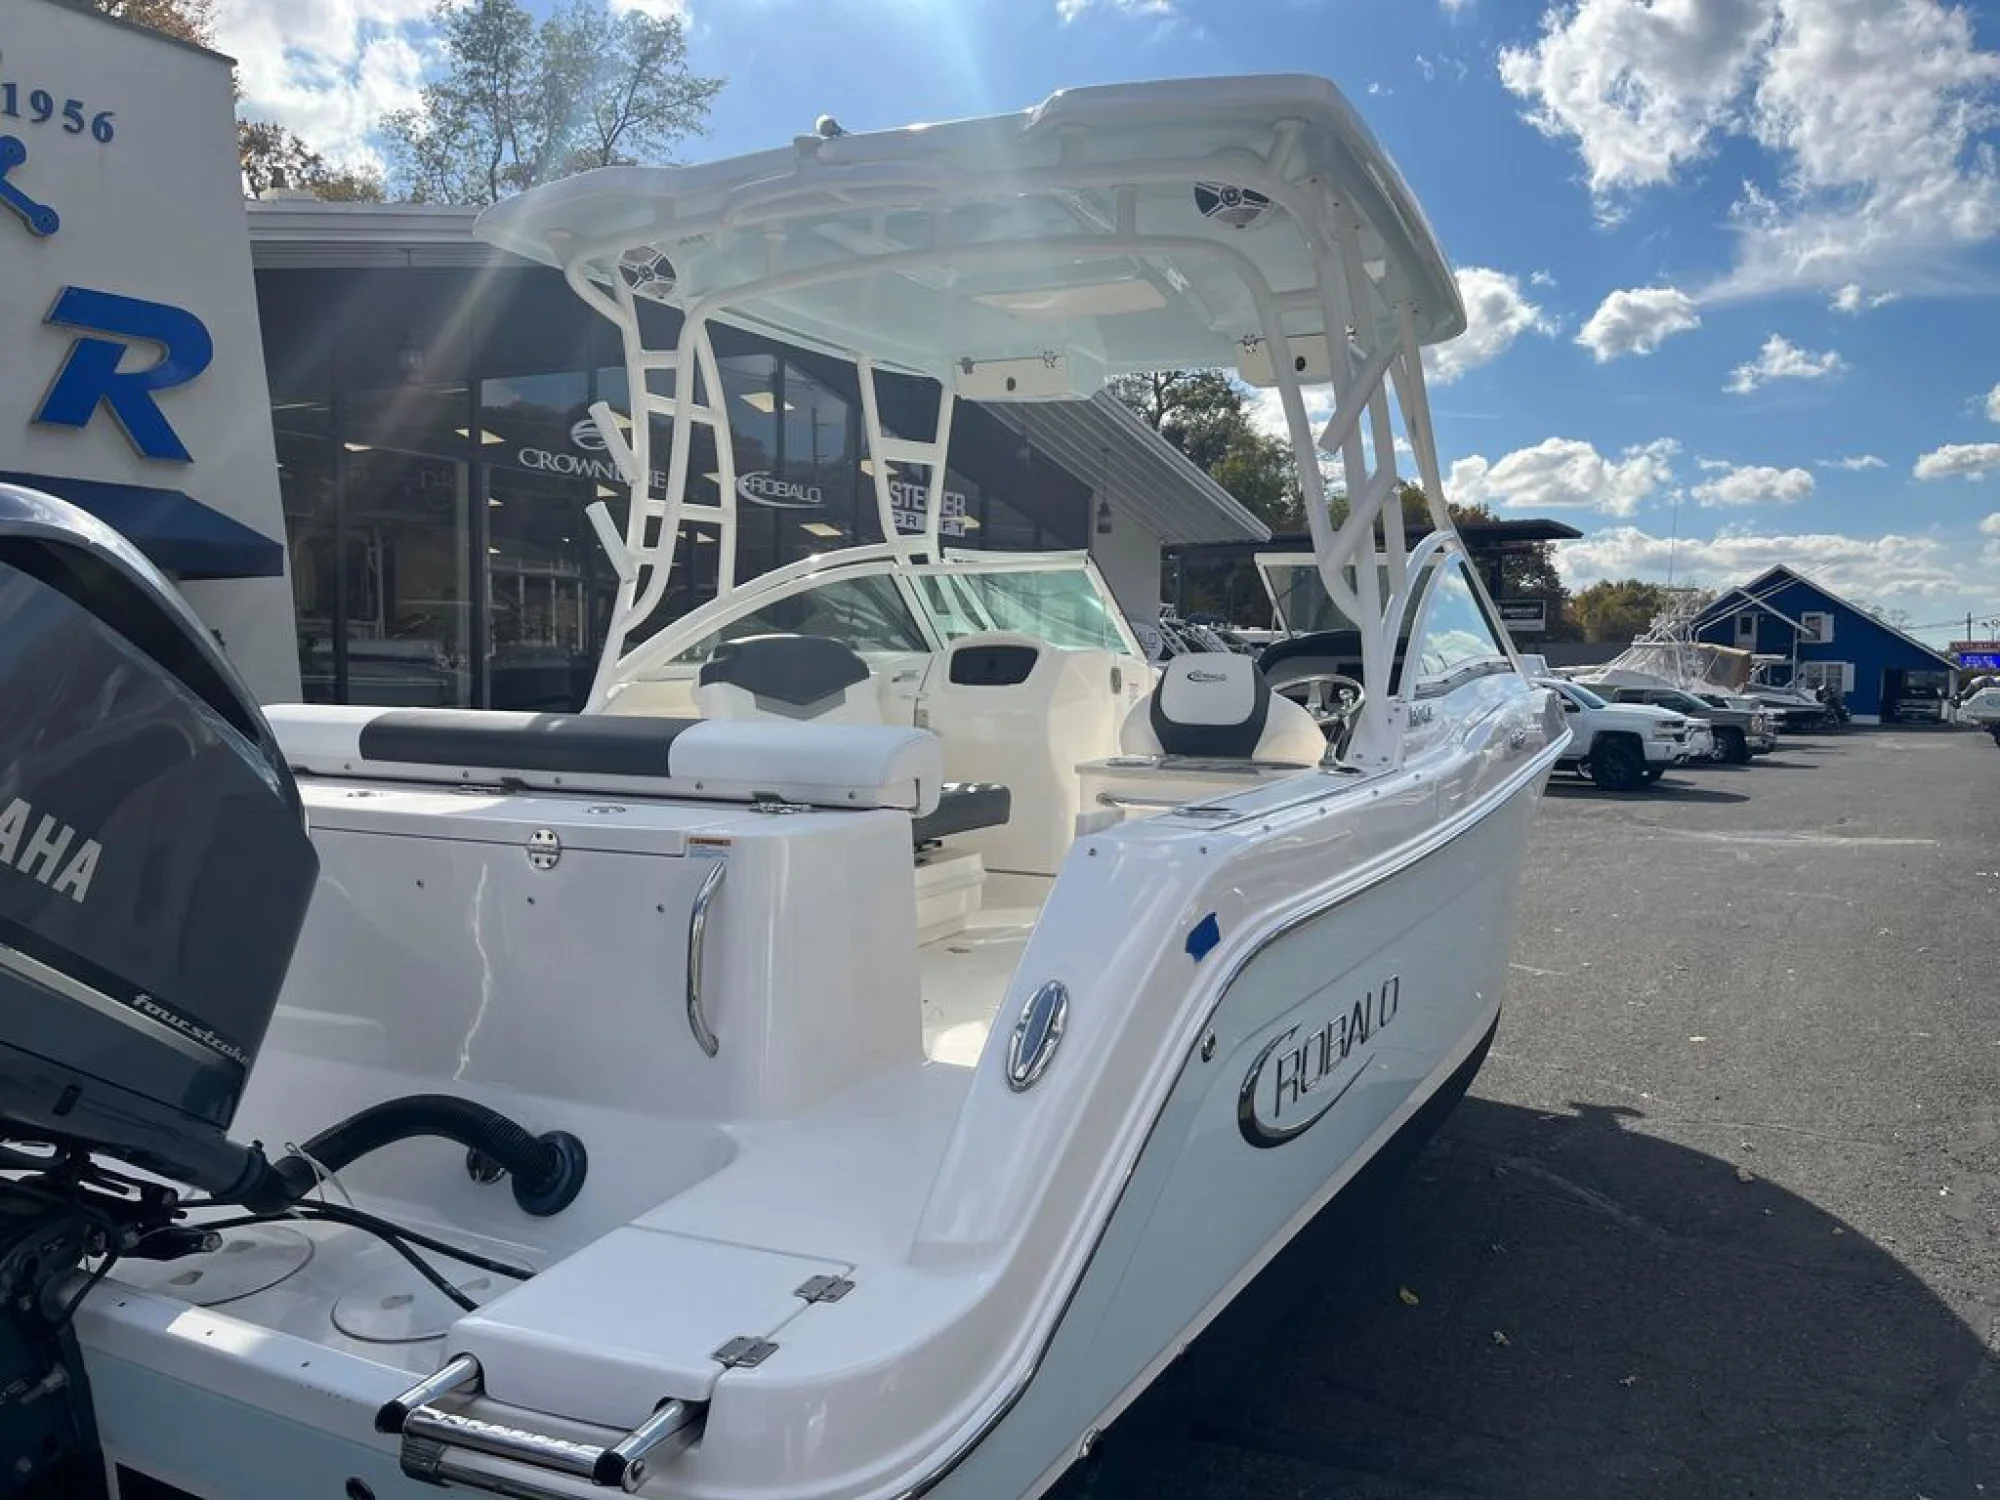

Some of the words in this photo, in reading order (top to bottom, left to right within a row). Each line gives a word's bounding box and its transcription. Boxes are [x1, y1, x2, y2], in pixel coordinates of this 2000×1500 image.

[0, 82, 116, 143] 1956
[30, 285, 214, 464] R
[750, 475, 822, 503] ROBALO
[1273, 974, 1400, 1120] ROBALO
